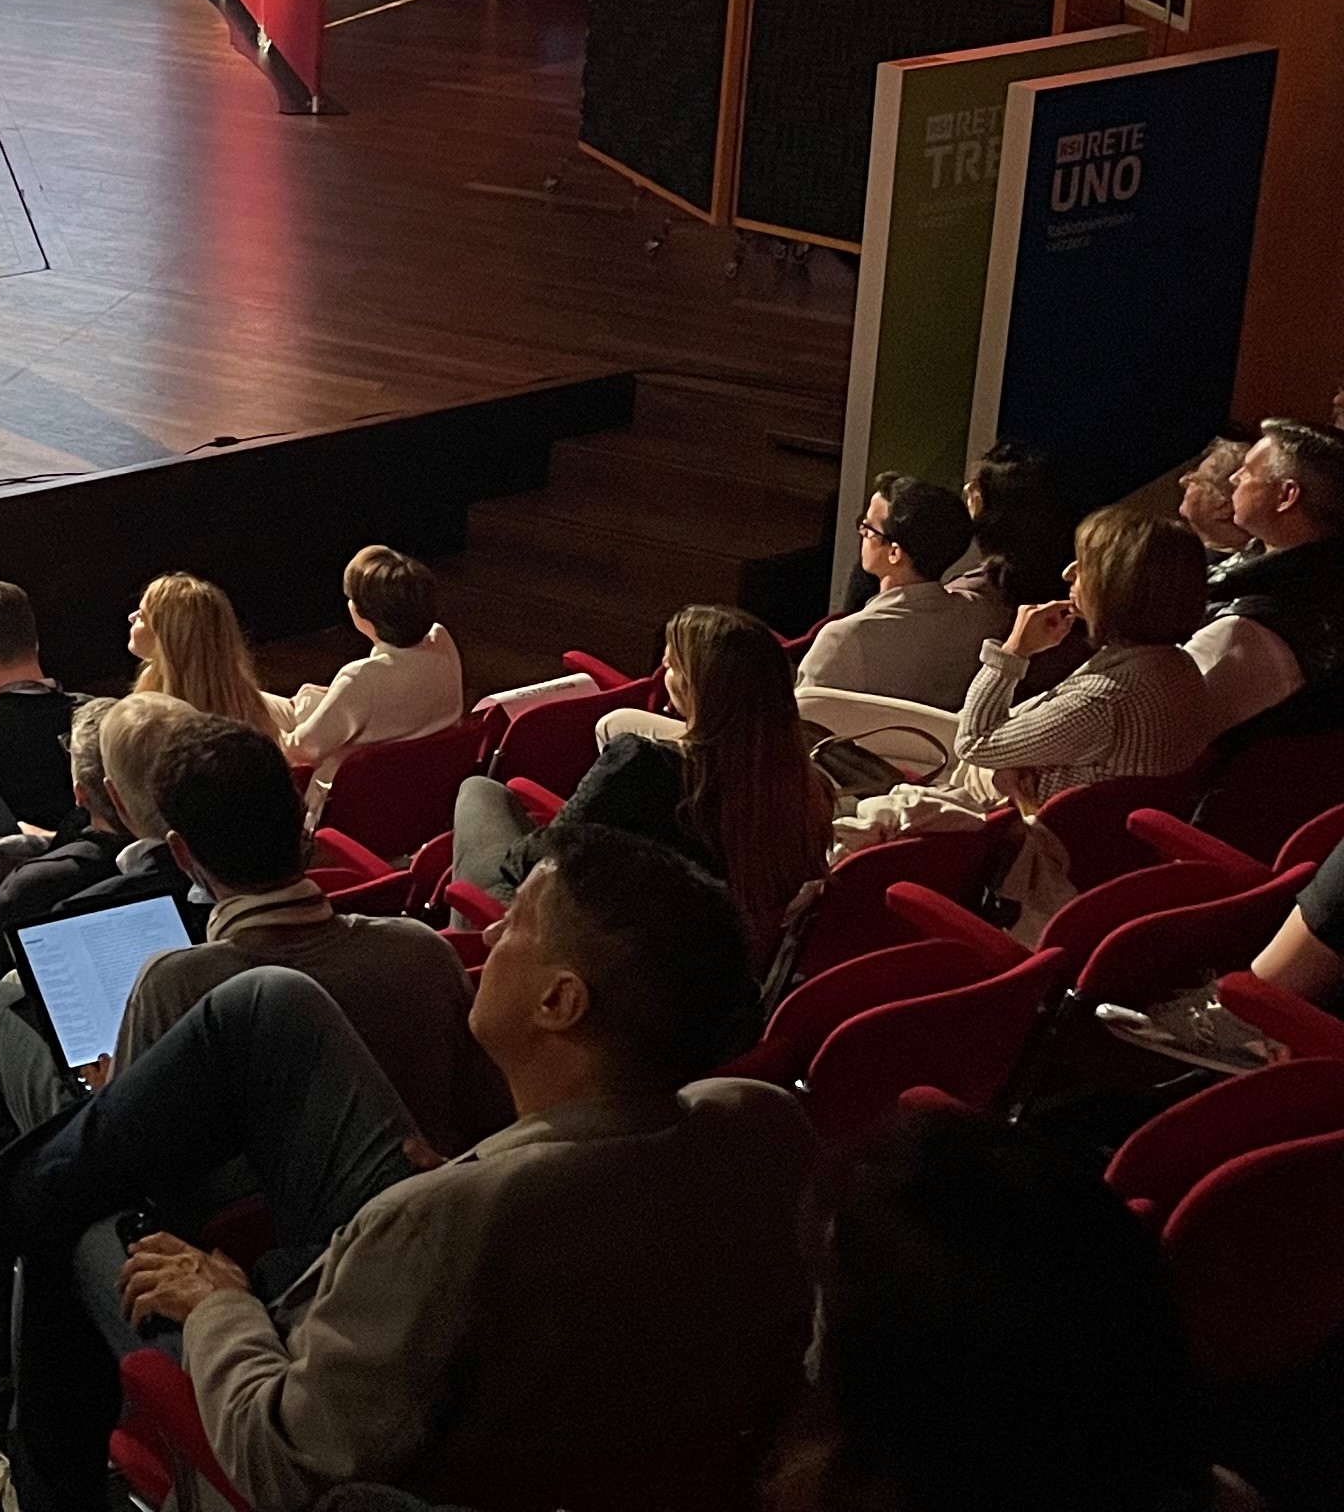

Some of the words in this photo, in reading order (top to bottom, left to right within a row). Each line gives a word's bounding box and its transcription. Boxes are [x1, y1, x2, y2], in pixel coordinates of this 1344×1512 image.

[956, 104, 1003, 137] RET
[1086, 122, 1147, 159] RETE
[1051, 155, 1142, 212] UNO
